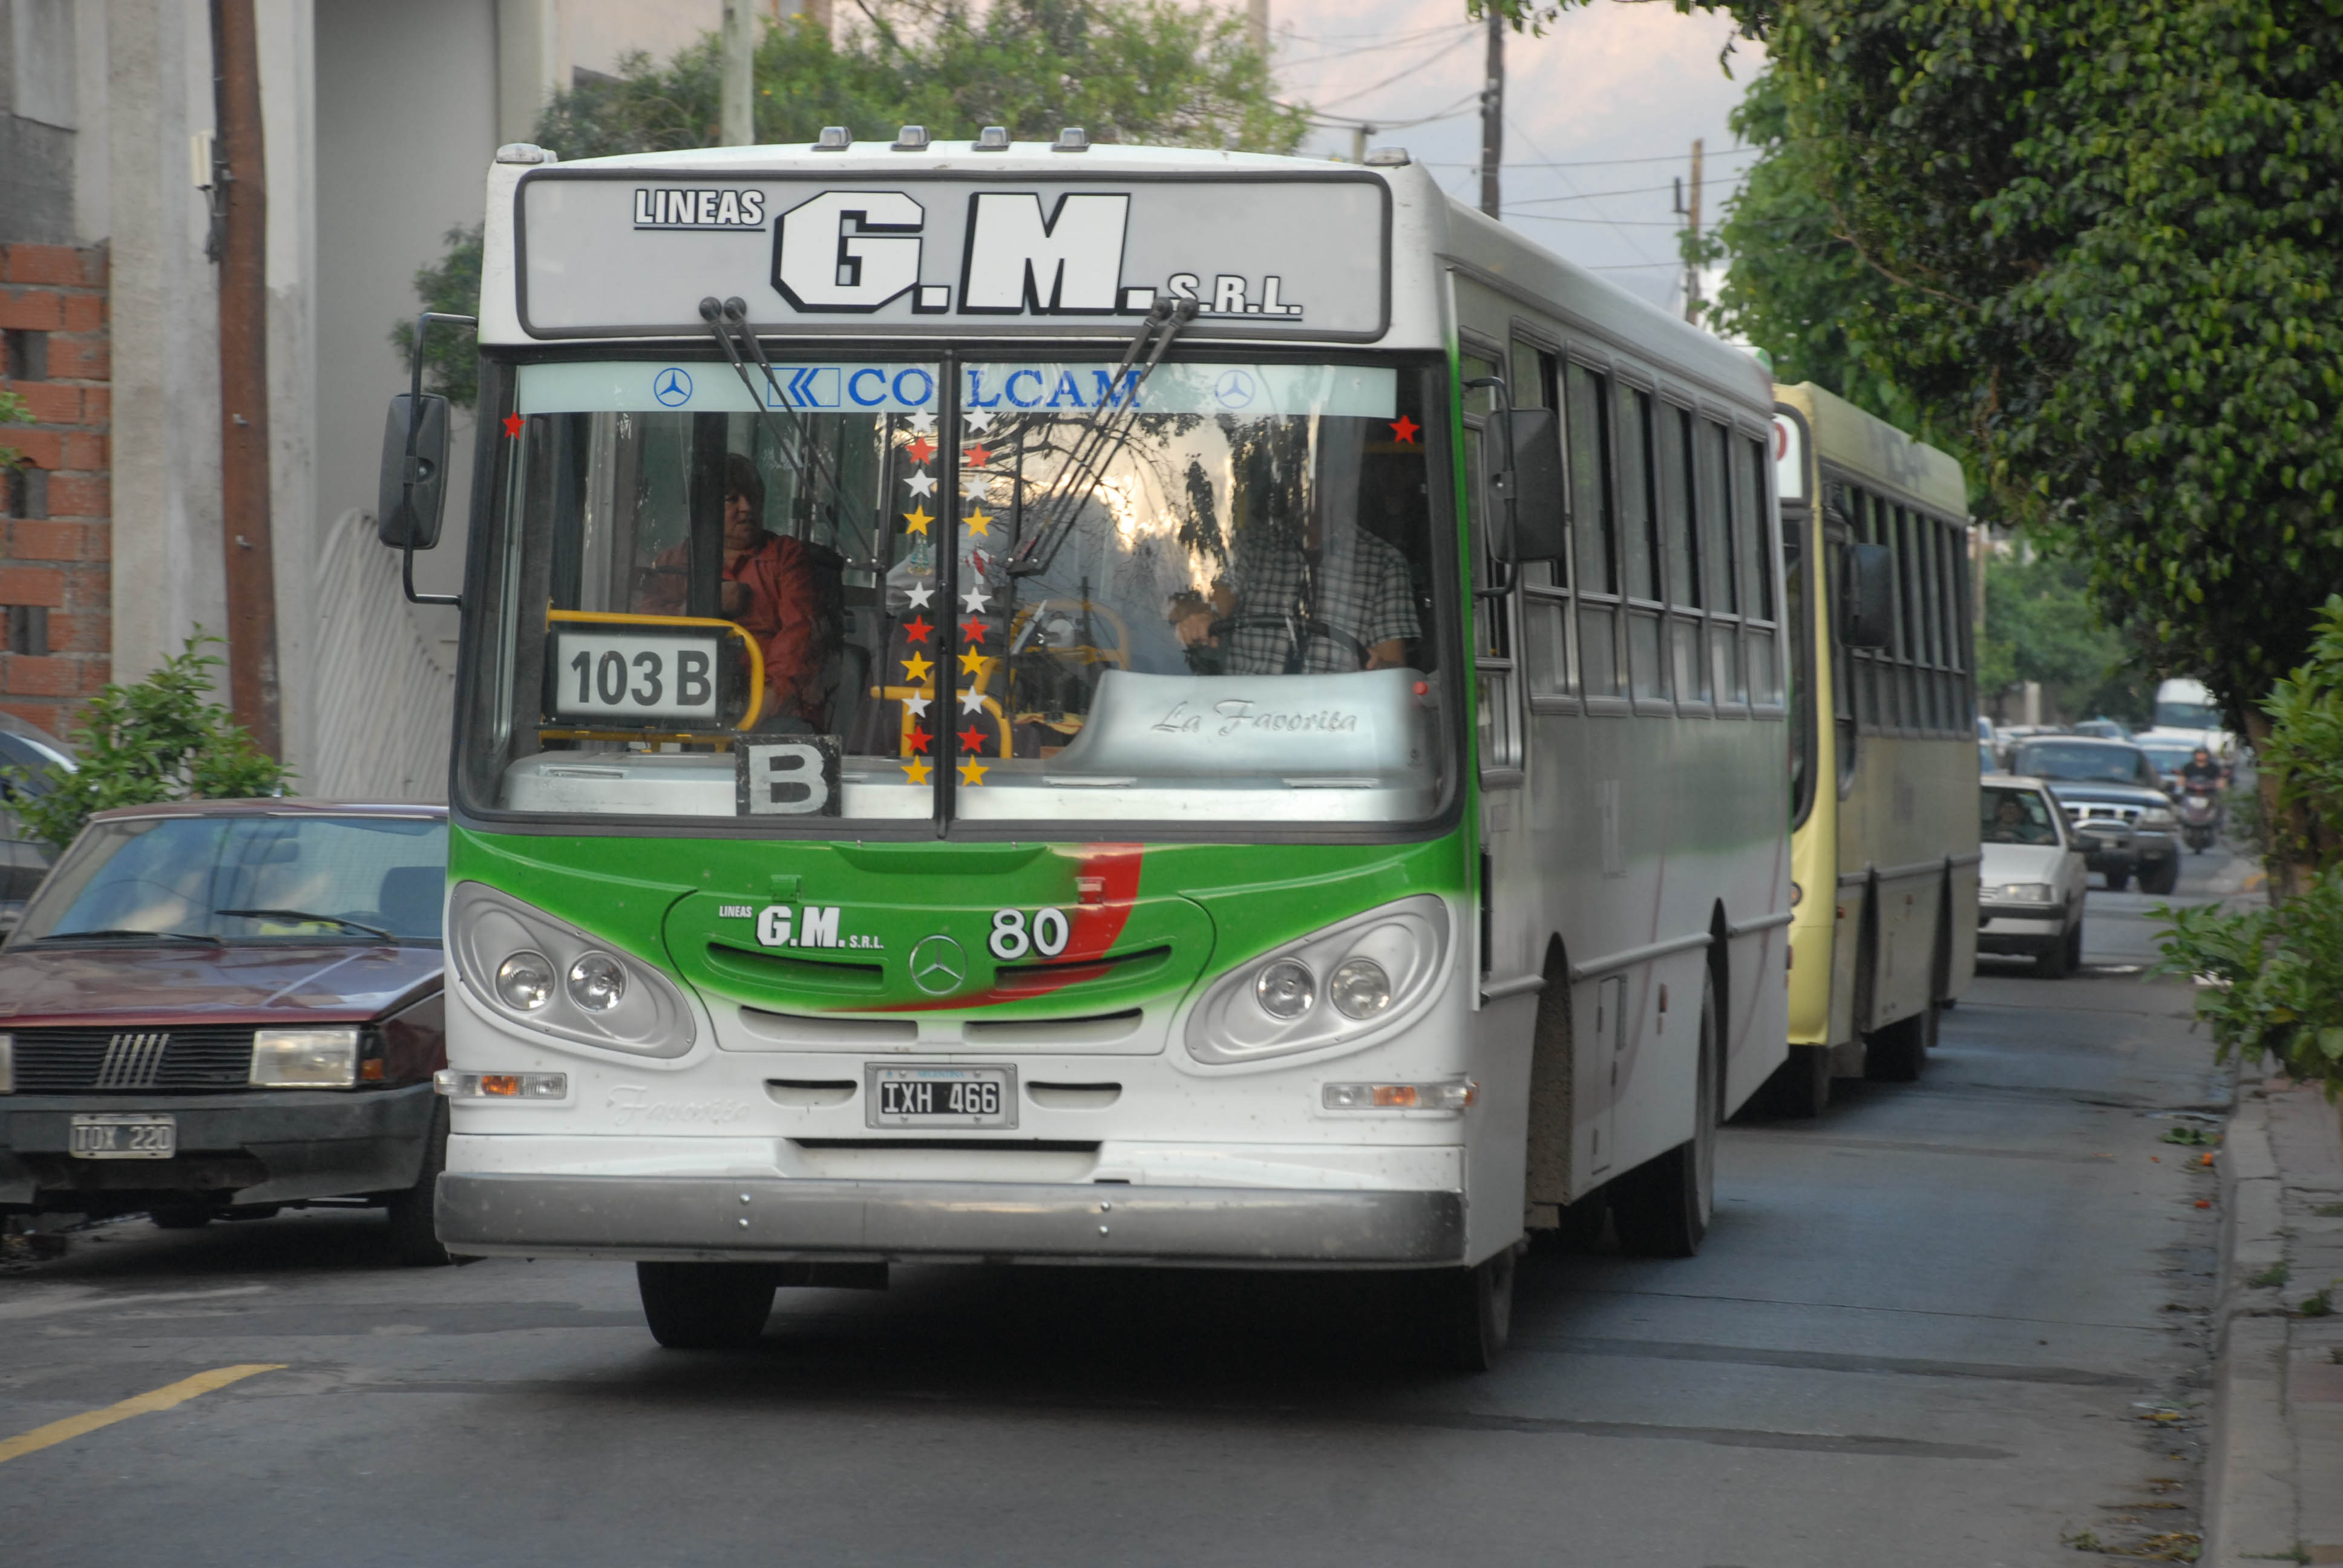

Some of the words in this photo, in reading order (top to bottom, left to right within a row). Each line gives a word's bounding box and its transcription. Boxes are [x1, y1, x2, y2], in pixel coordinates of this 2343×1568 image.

[635, 189, 765, 226] LINEAS
[771, 190, 1156, 315] G.M.
[1150, 701, 1201, 733] La
[1213, 699, 1357, 736] Favorita
[749, 743, 828, 815] B
[719, 906, 753, 918] LINEAS
[756, 905, 845, 948] G.M.
[849, 935, 885, 949] S.R.L.
[987, 907, 1070, 961] 80
[883, 1083, 933, 1113] IXH
[949, 1083, 997, 1113] 466
